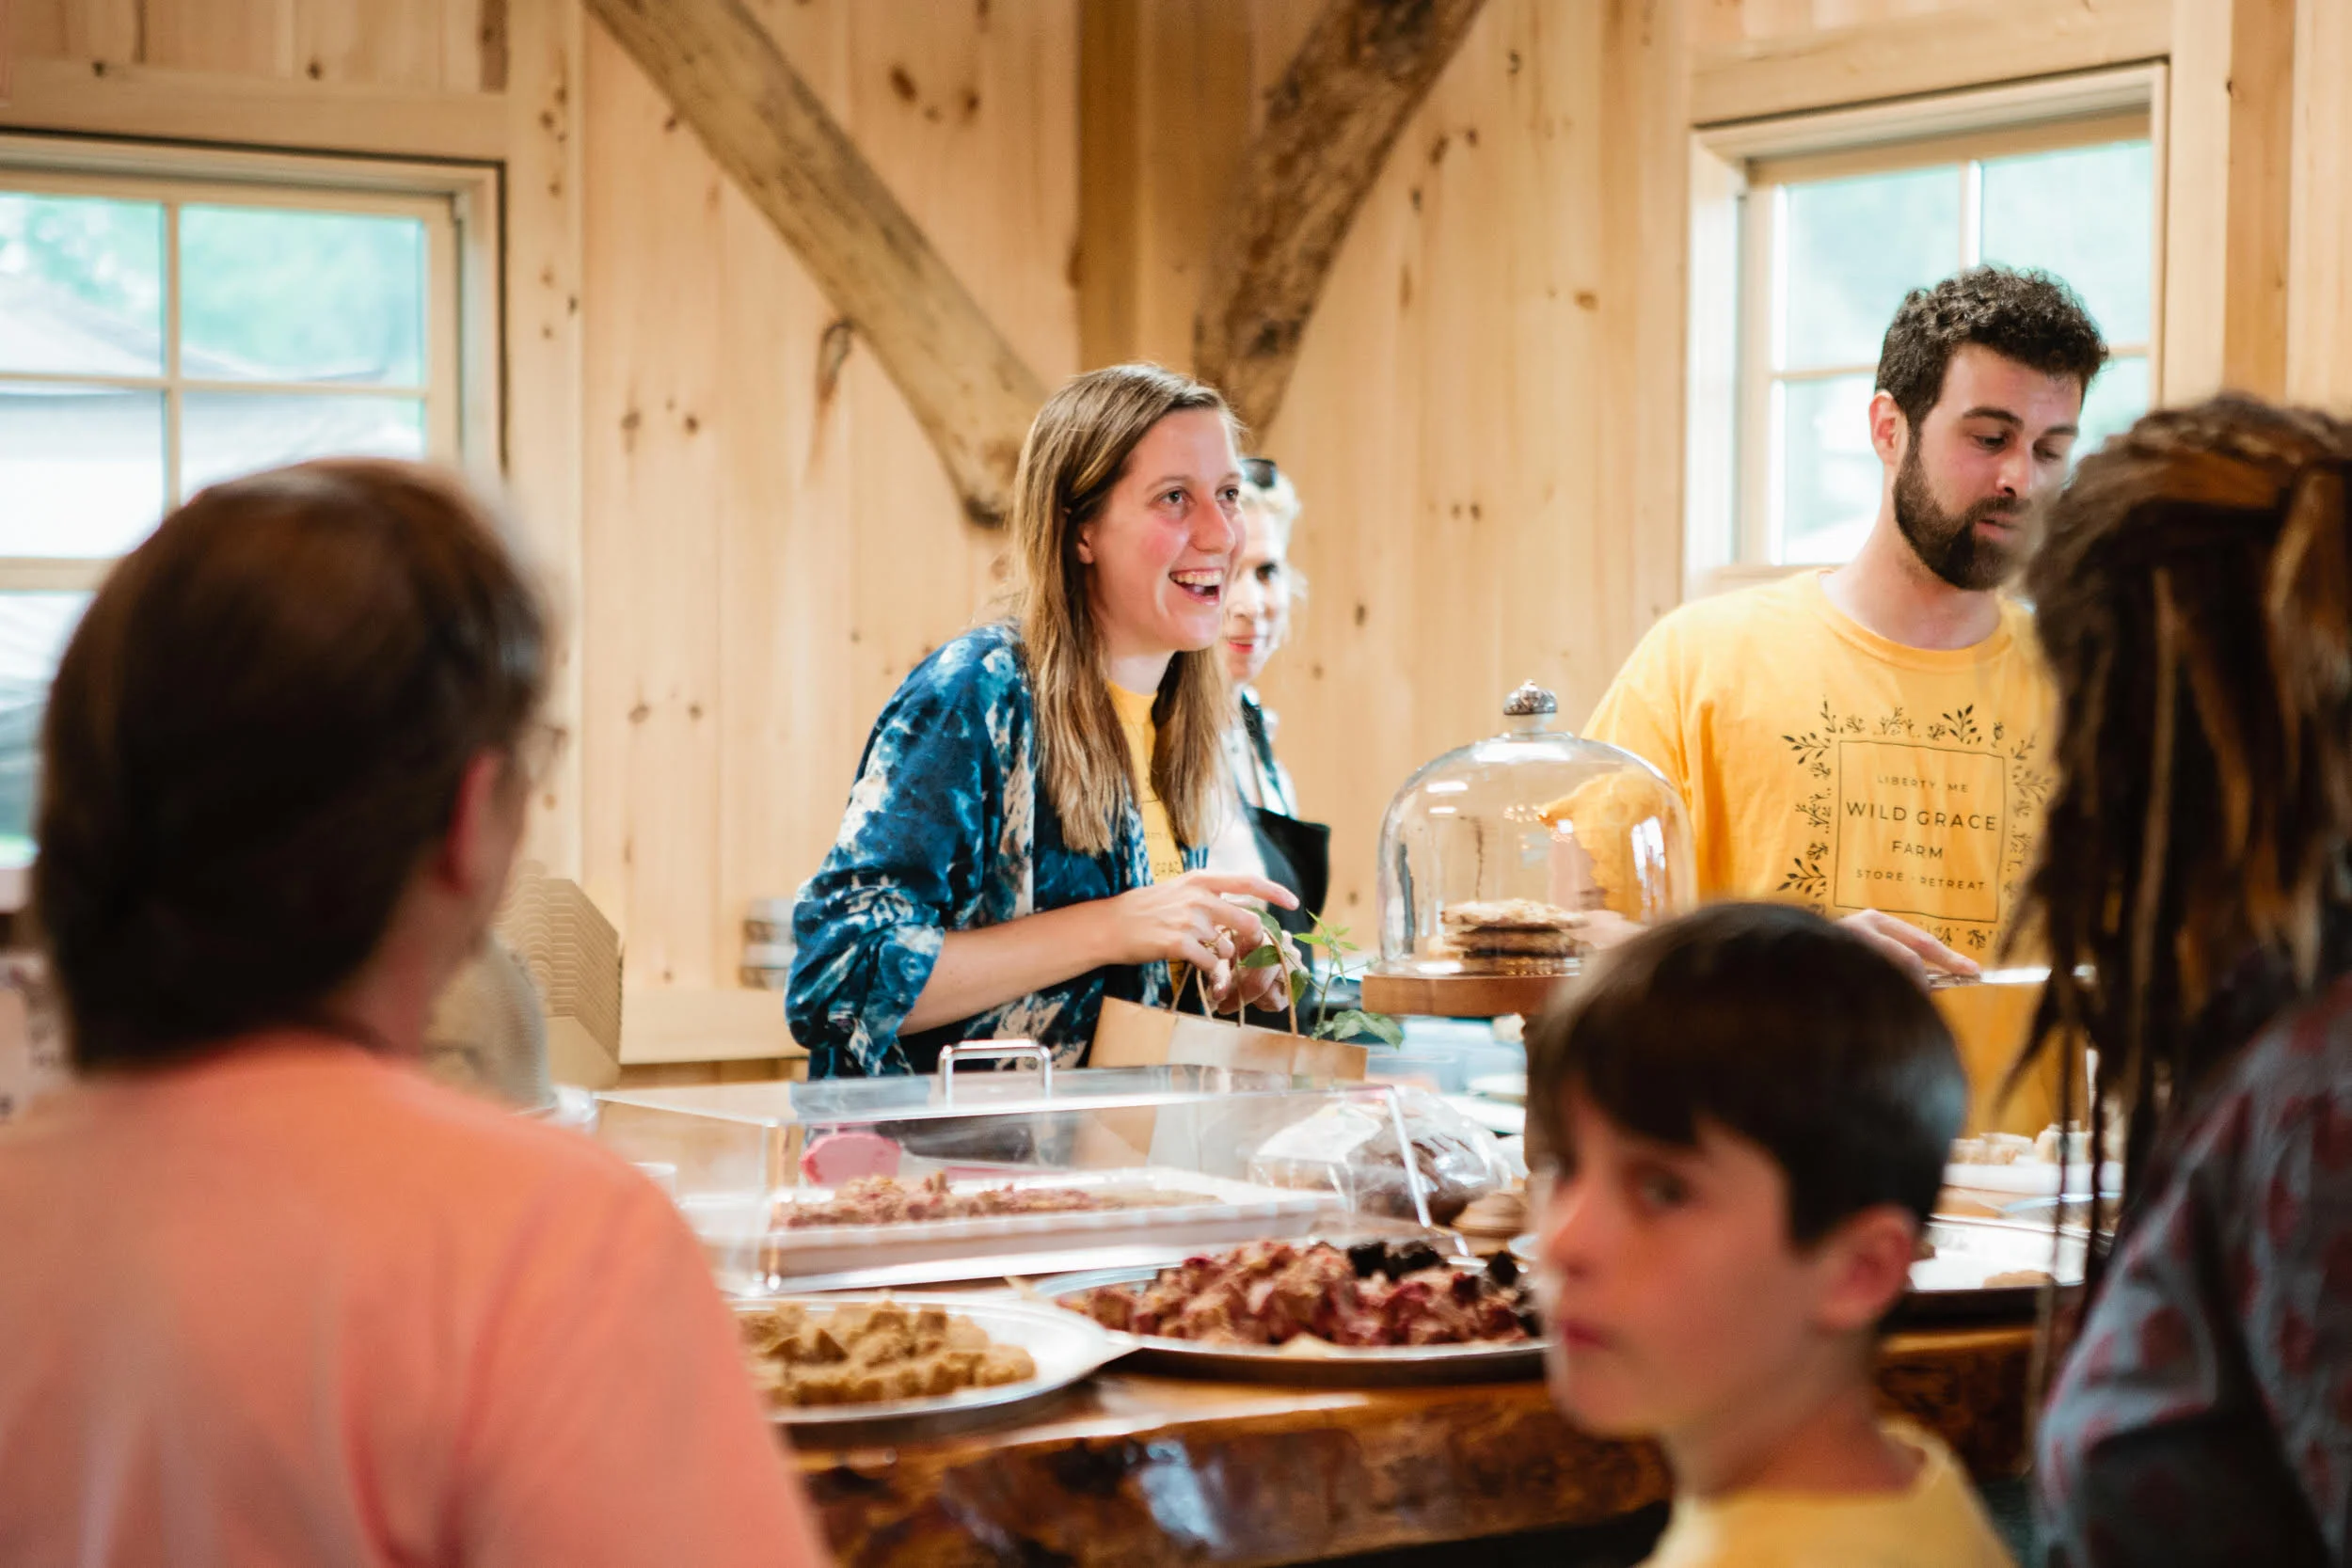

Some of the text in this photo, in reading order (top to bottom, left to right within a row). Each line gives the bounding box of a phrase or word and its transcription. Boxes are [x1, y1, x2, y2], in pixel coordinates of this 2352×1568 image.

[1947, 783, 1969, 793] ME
[1846, 800, 1996, 831] WILD GRACE
[1891, 840, 1944, 859] FARM
[1154, 860, 1182, 877] GRAC
[1856, 869, 1985, 890] STORE RETREAT
